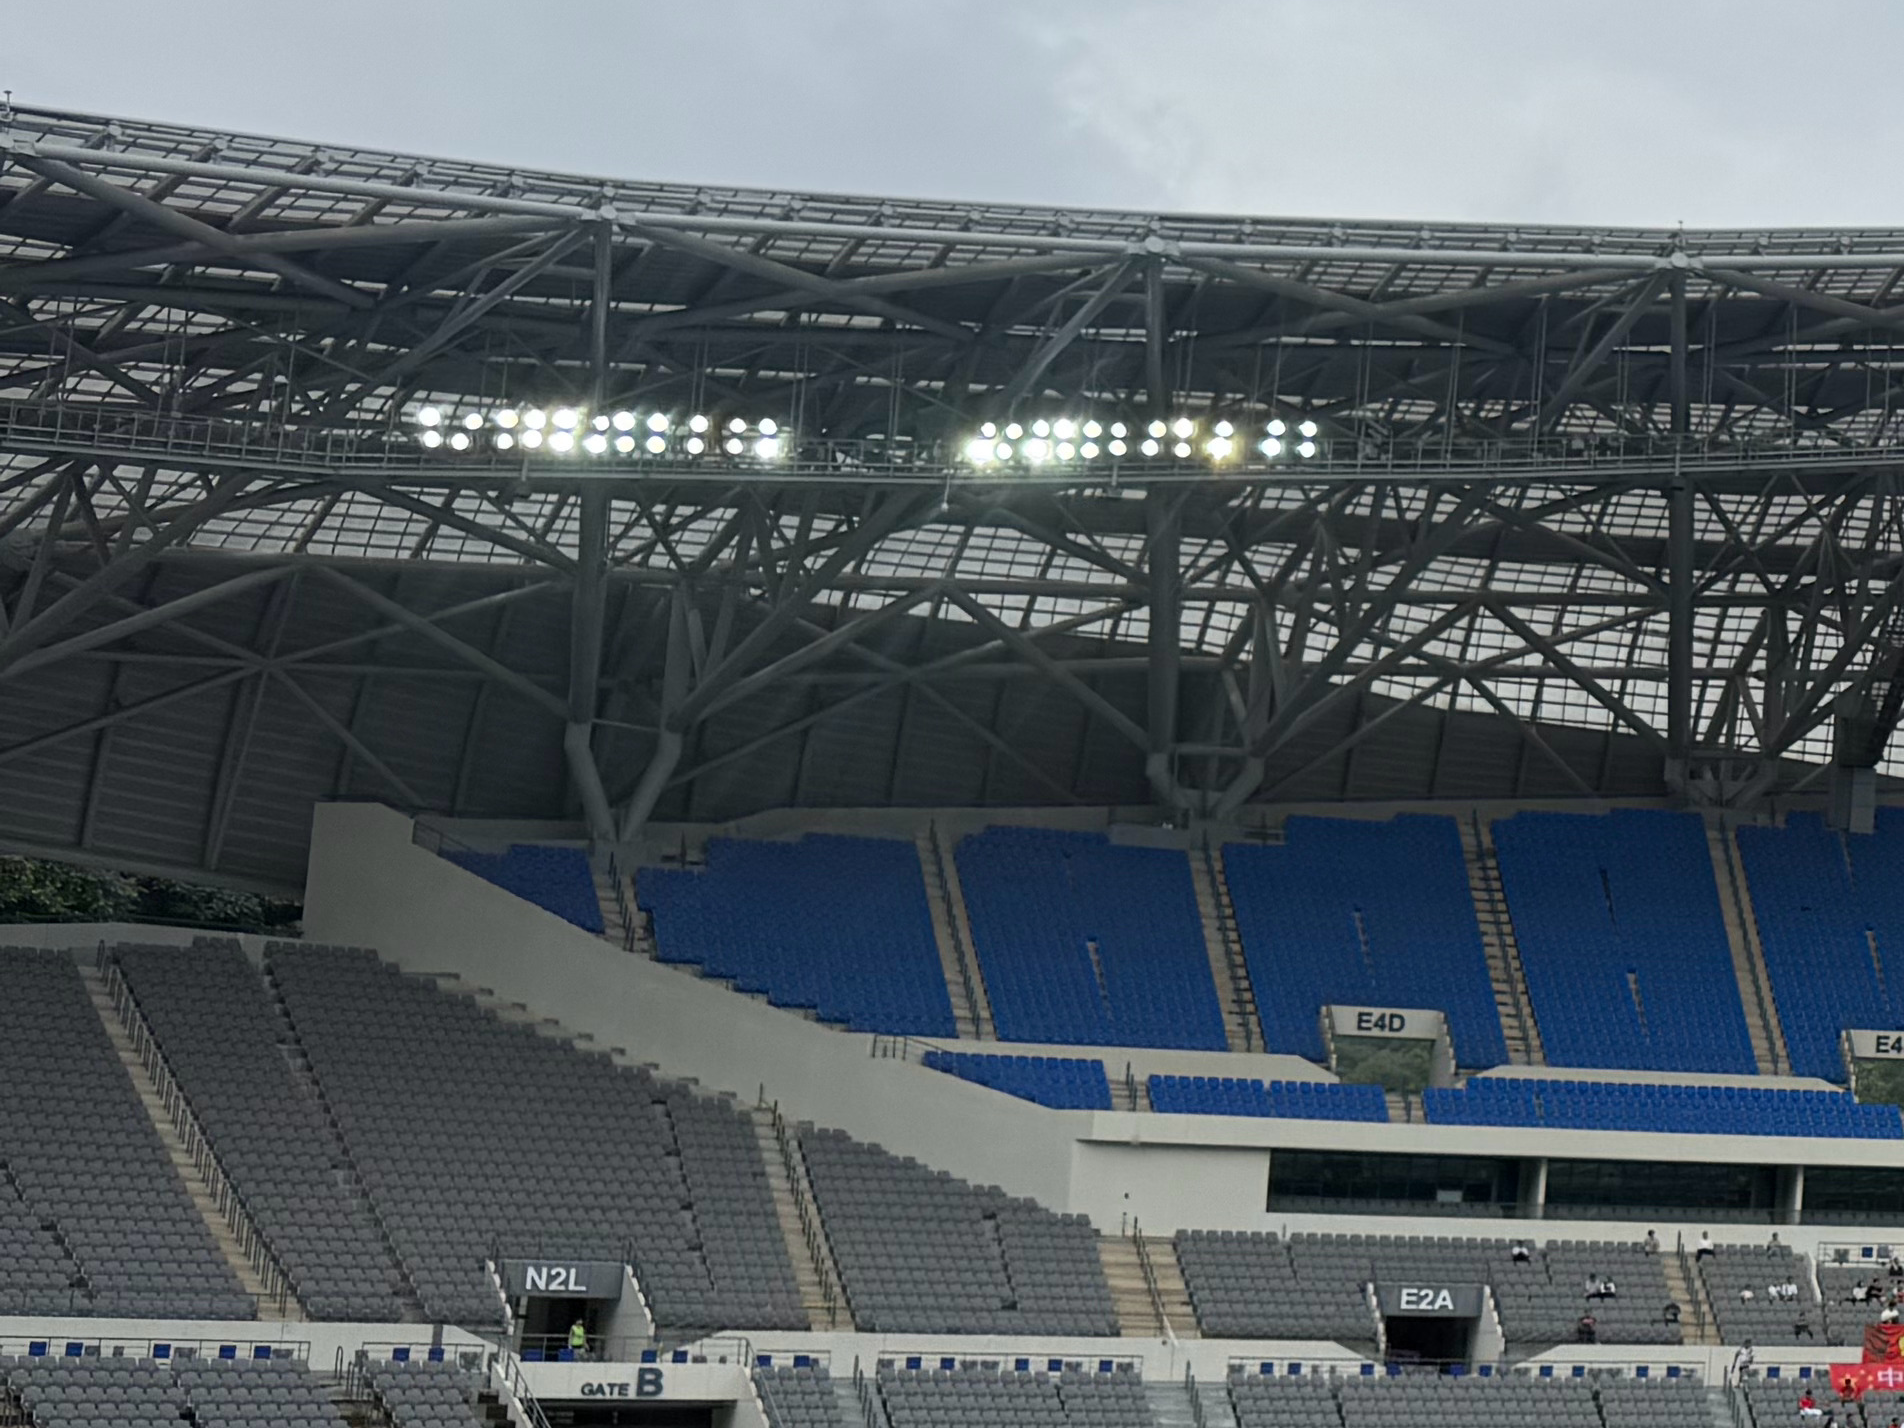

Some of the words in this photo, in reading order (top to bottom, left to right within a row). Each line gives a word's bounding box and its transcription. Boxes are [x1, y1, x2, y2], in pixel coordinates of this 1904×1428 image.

[1356, 1012, 1404, 1033] E4D
[525, 1267, 587, 1292] N2L
[1400, 1289, 1454, 1311] E2A
[581, 1383, 628, 1397] GATE
[636, 1368, 663, 1397] B
